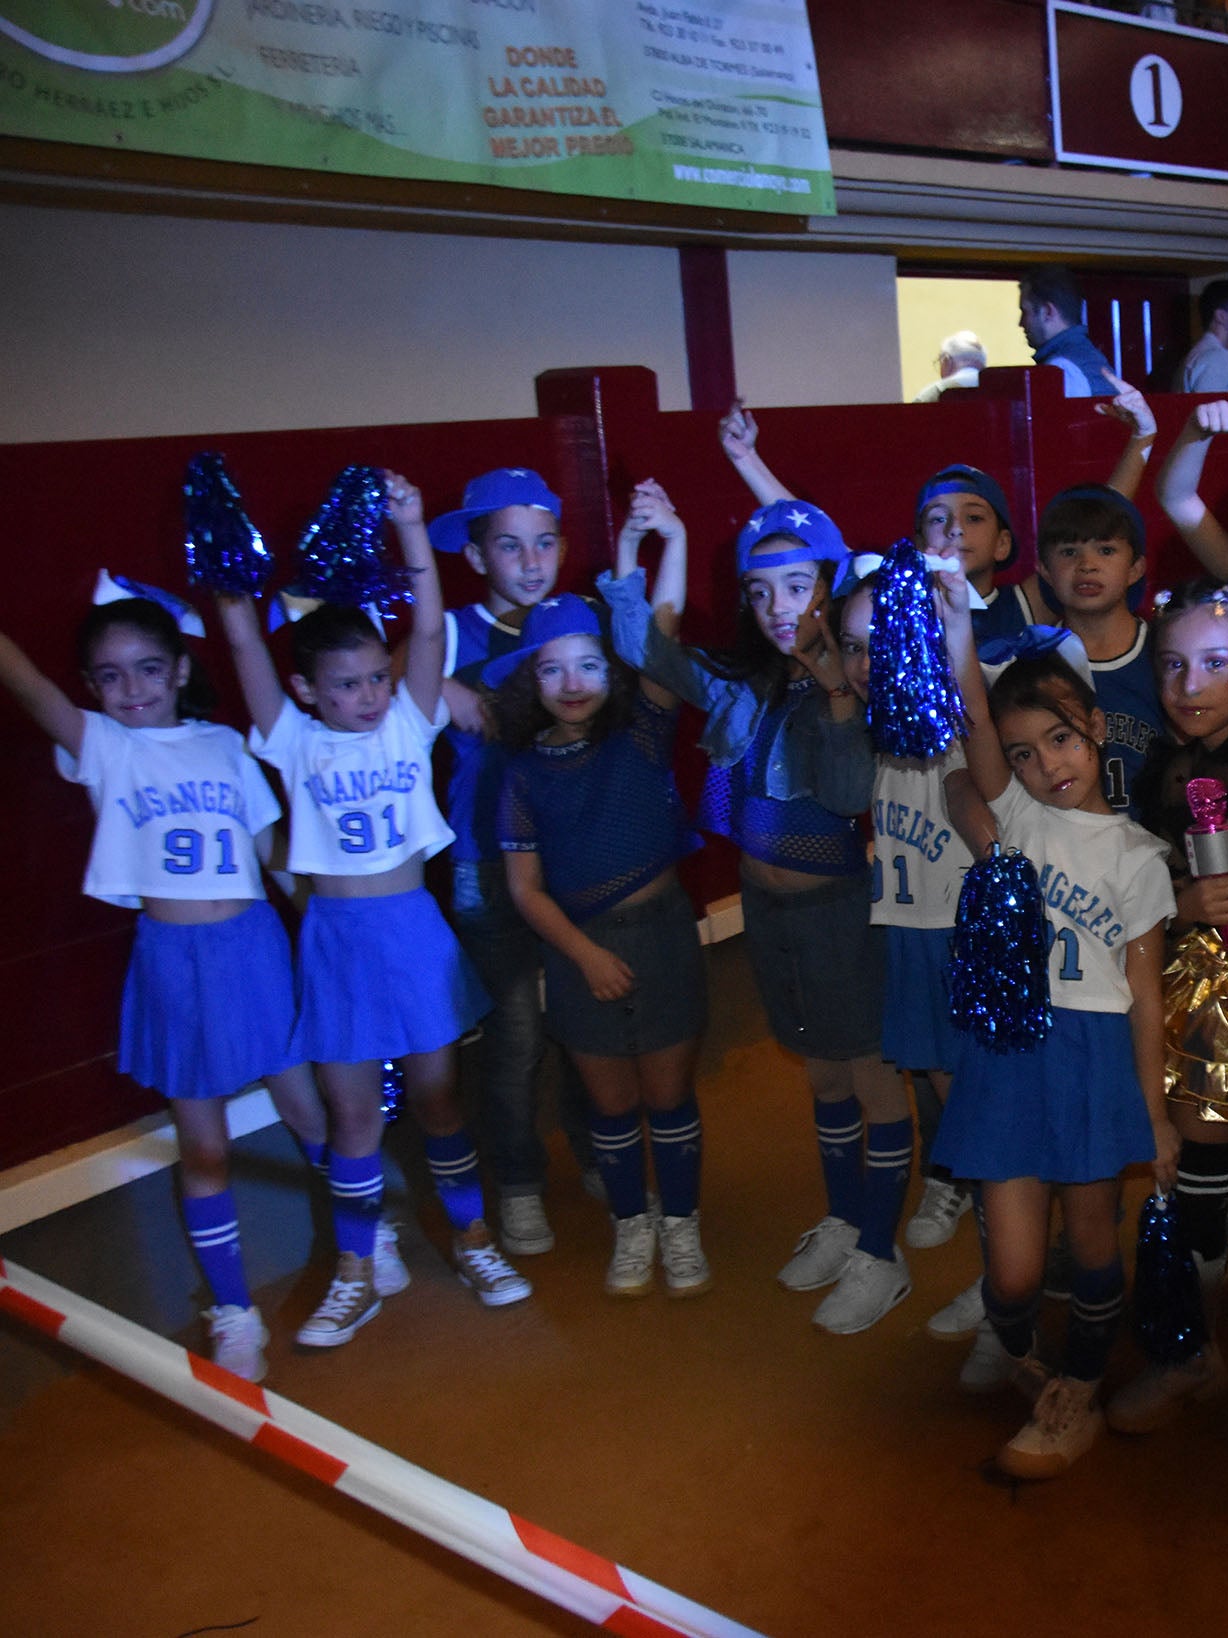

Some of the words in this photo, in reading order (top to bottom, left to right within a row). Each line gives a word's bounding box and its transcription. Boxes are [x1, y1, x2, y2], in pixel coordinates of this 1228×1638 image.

[505, 45, 578, 68] DONDE
[488, 76, 518, 97] LA
[520, 76, 606, 97] CALIDAD
[1145, 62, 1169, 127] 1
[483, 105, 598, 128] GARANTIZA
[600, 106, 624, 127] EL
[490, 136, 560, 158] MEJOR
[1106, 758, 1130, 807] 1
[337, 804, 406, 854] 91
[164, 828, 239, 875] 91
